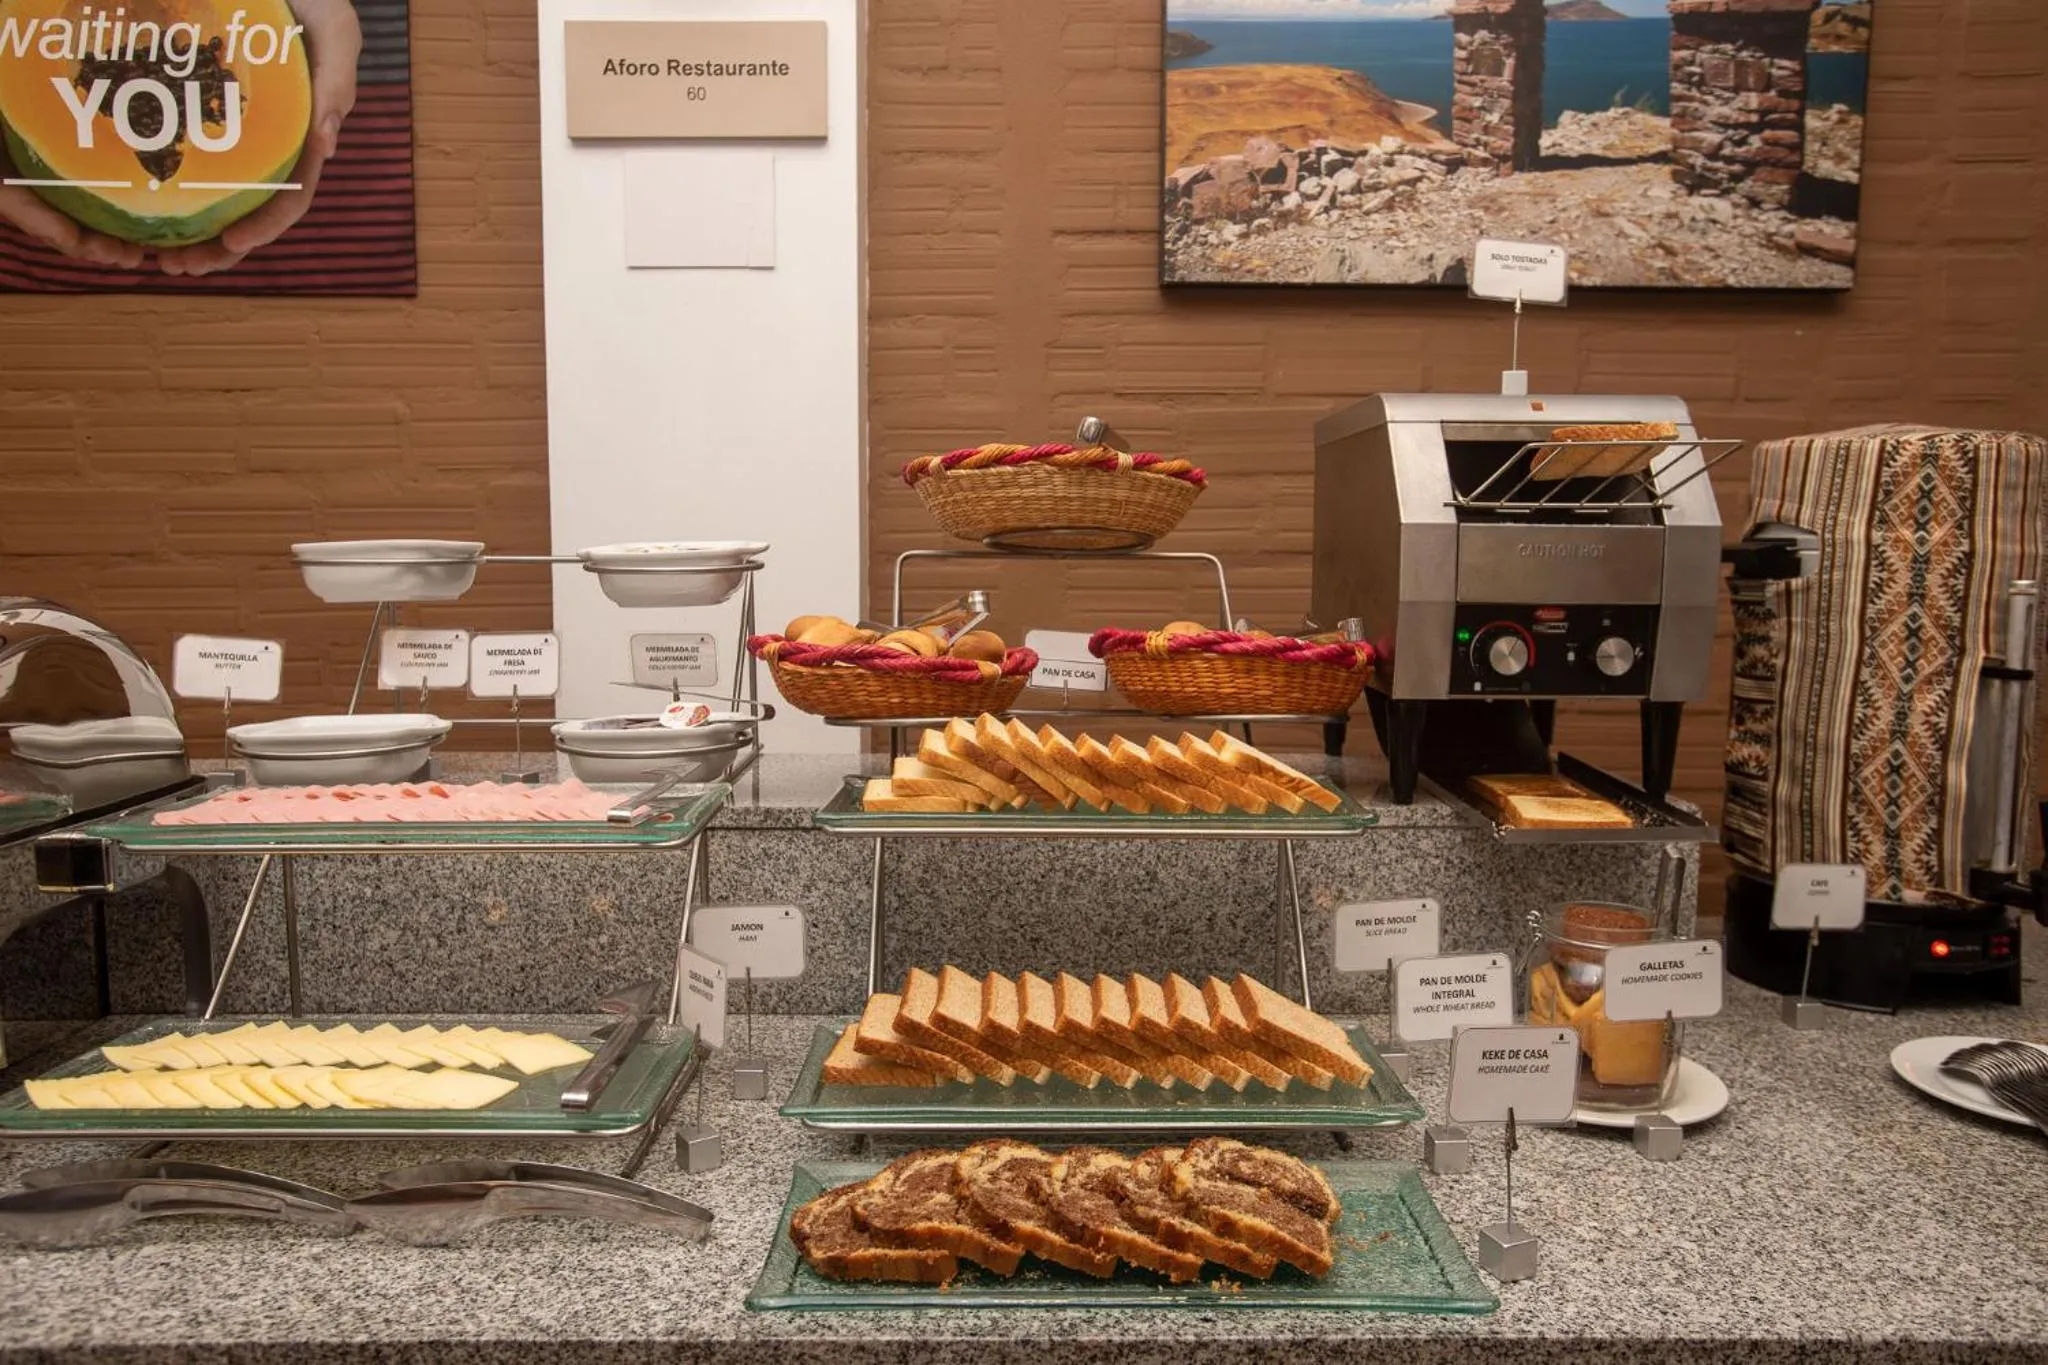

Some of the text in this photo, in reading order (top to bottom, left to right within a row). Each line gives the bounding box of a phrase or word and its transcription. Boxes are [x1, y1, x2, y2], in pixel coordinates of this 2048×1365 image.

[0, 5, 304, 77] waiting for
[602, 58, 791, 77] Aforo Restaurante
[686, 86, 707, 101] 60
[50, 77, 243, 153] YOU
[1519, 543, 1606, 557] CAUTION HOT
[198, 651, 259, 663] MANTEQUILLA
[486, 648, 543, 657] MERMELADA DE
[503, 659, 525, 667] FRESA
[1042, 667, 1097, 680] PAN DE CASA
[1355, 915, 1417, 927] PAN DE MOLDE
[1384, 927, 1408, 936] BREAD
[1639, 960, 1685, 971] GALLETAS
[1419, 973, 1488, 987] PAN DE MOLDE
[1621, 971, 1704, 984] HOMEMADE COOKIES
[1431, 988, 1476, 1000] INTEGRAL
[1412, 1001, 1497, 1014] WHOLE WHEAT BREAD
[1482, 1049, 1549, 1060] KEKE DE CASA
[1478, 1064, 1552, 1074] HOMEMADE CAKE
